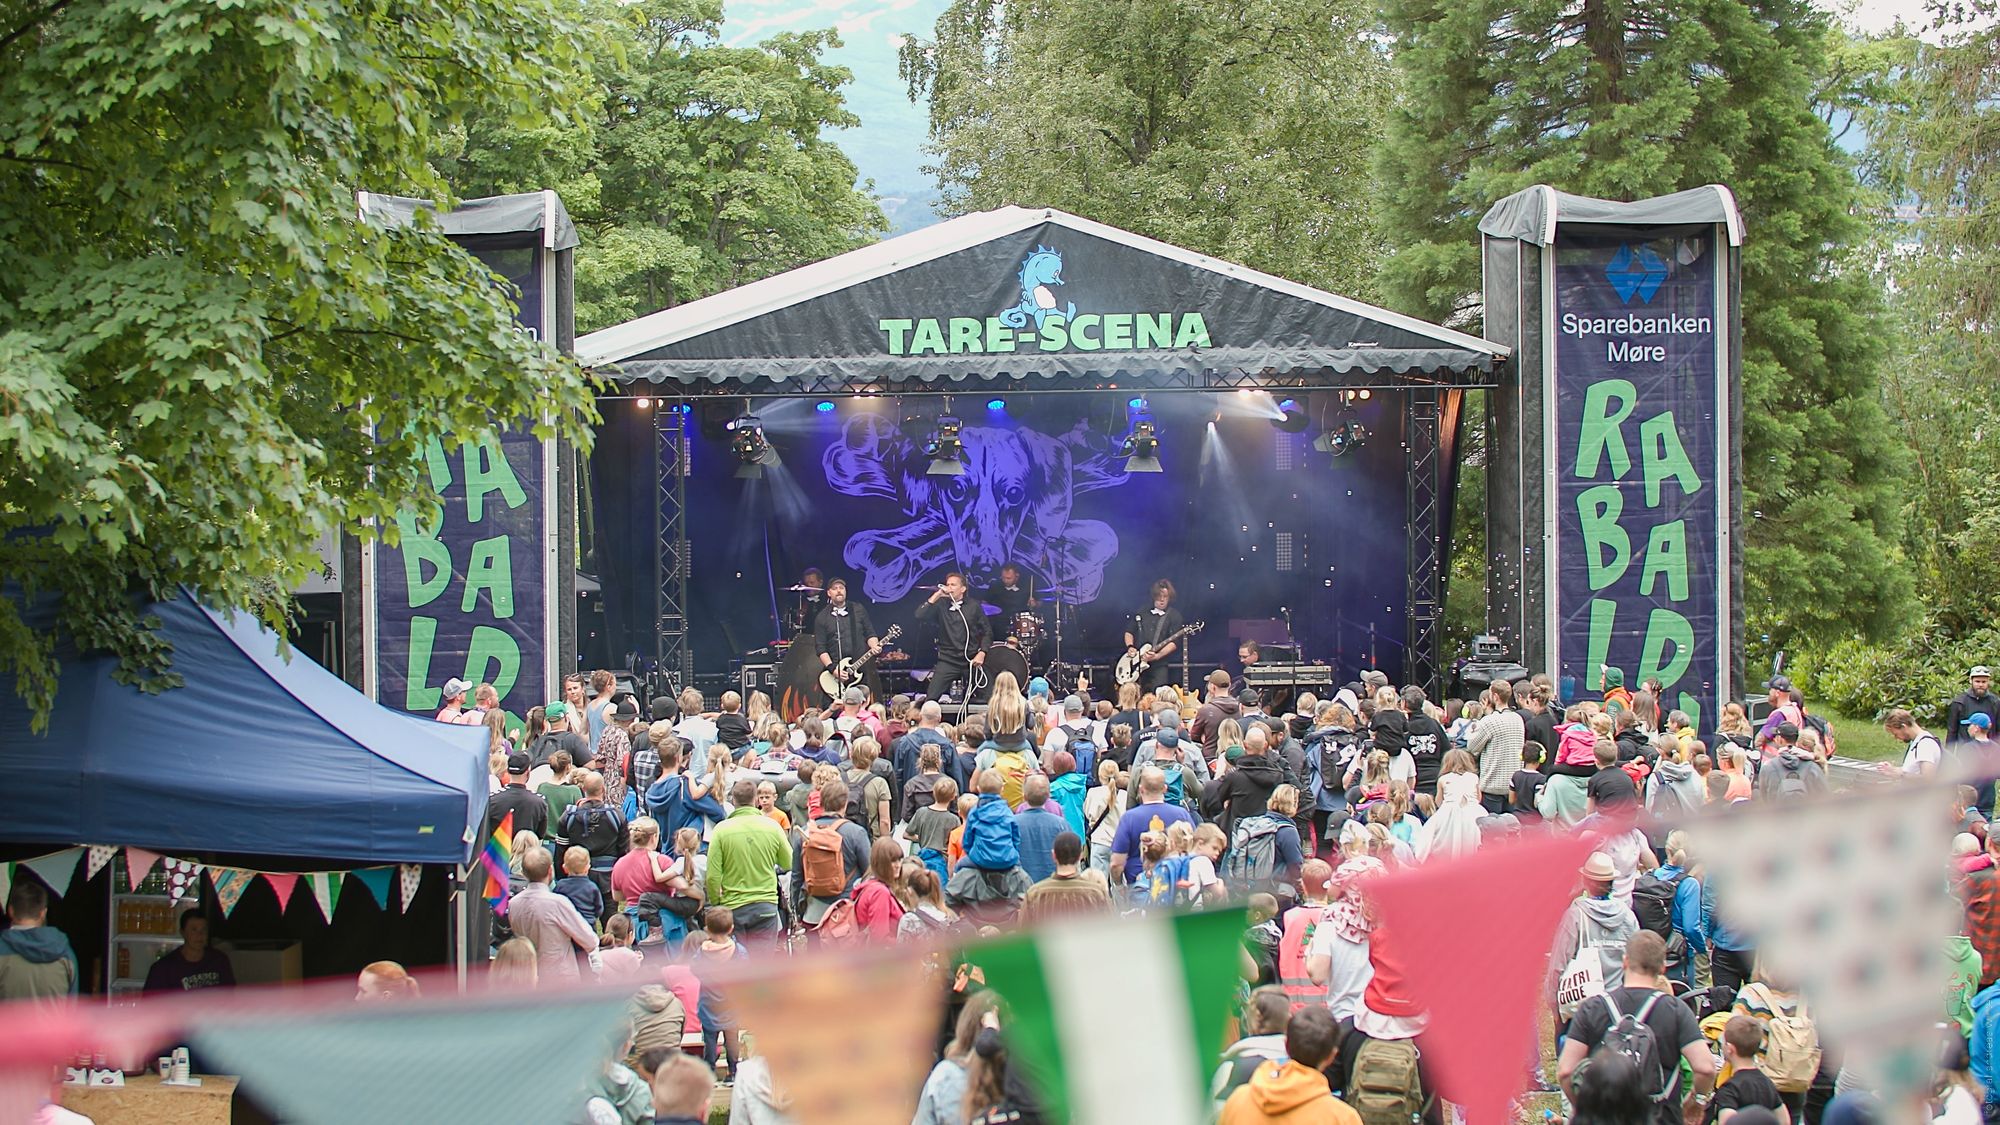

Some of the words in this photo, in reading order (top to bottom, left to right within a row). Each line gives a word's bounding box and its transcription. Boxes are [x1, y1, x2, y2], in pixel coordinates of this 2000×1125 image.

[879, 312, 1213, 355] TARE-SCENA
[1562, 313, 1711, 338] Sparebanken
[1607, 341, 1666, 362] Møre
